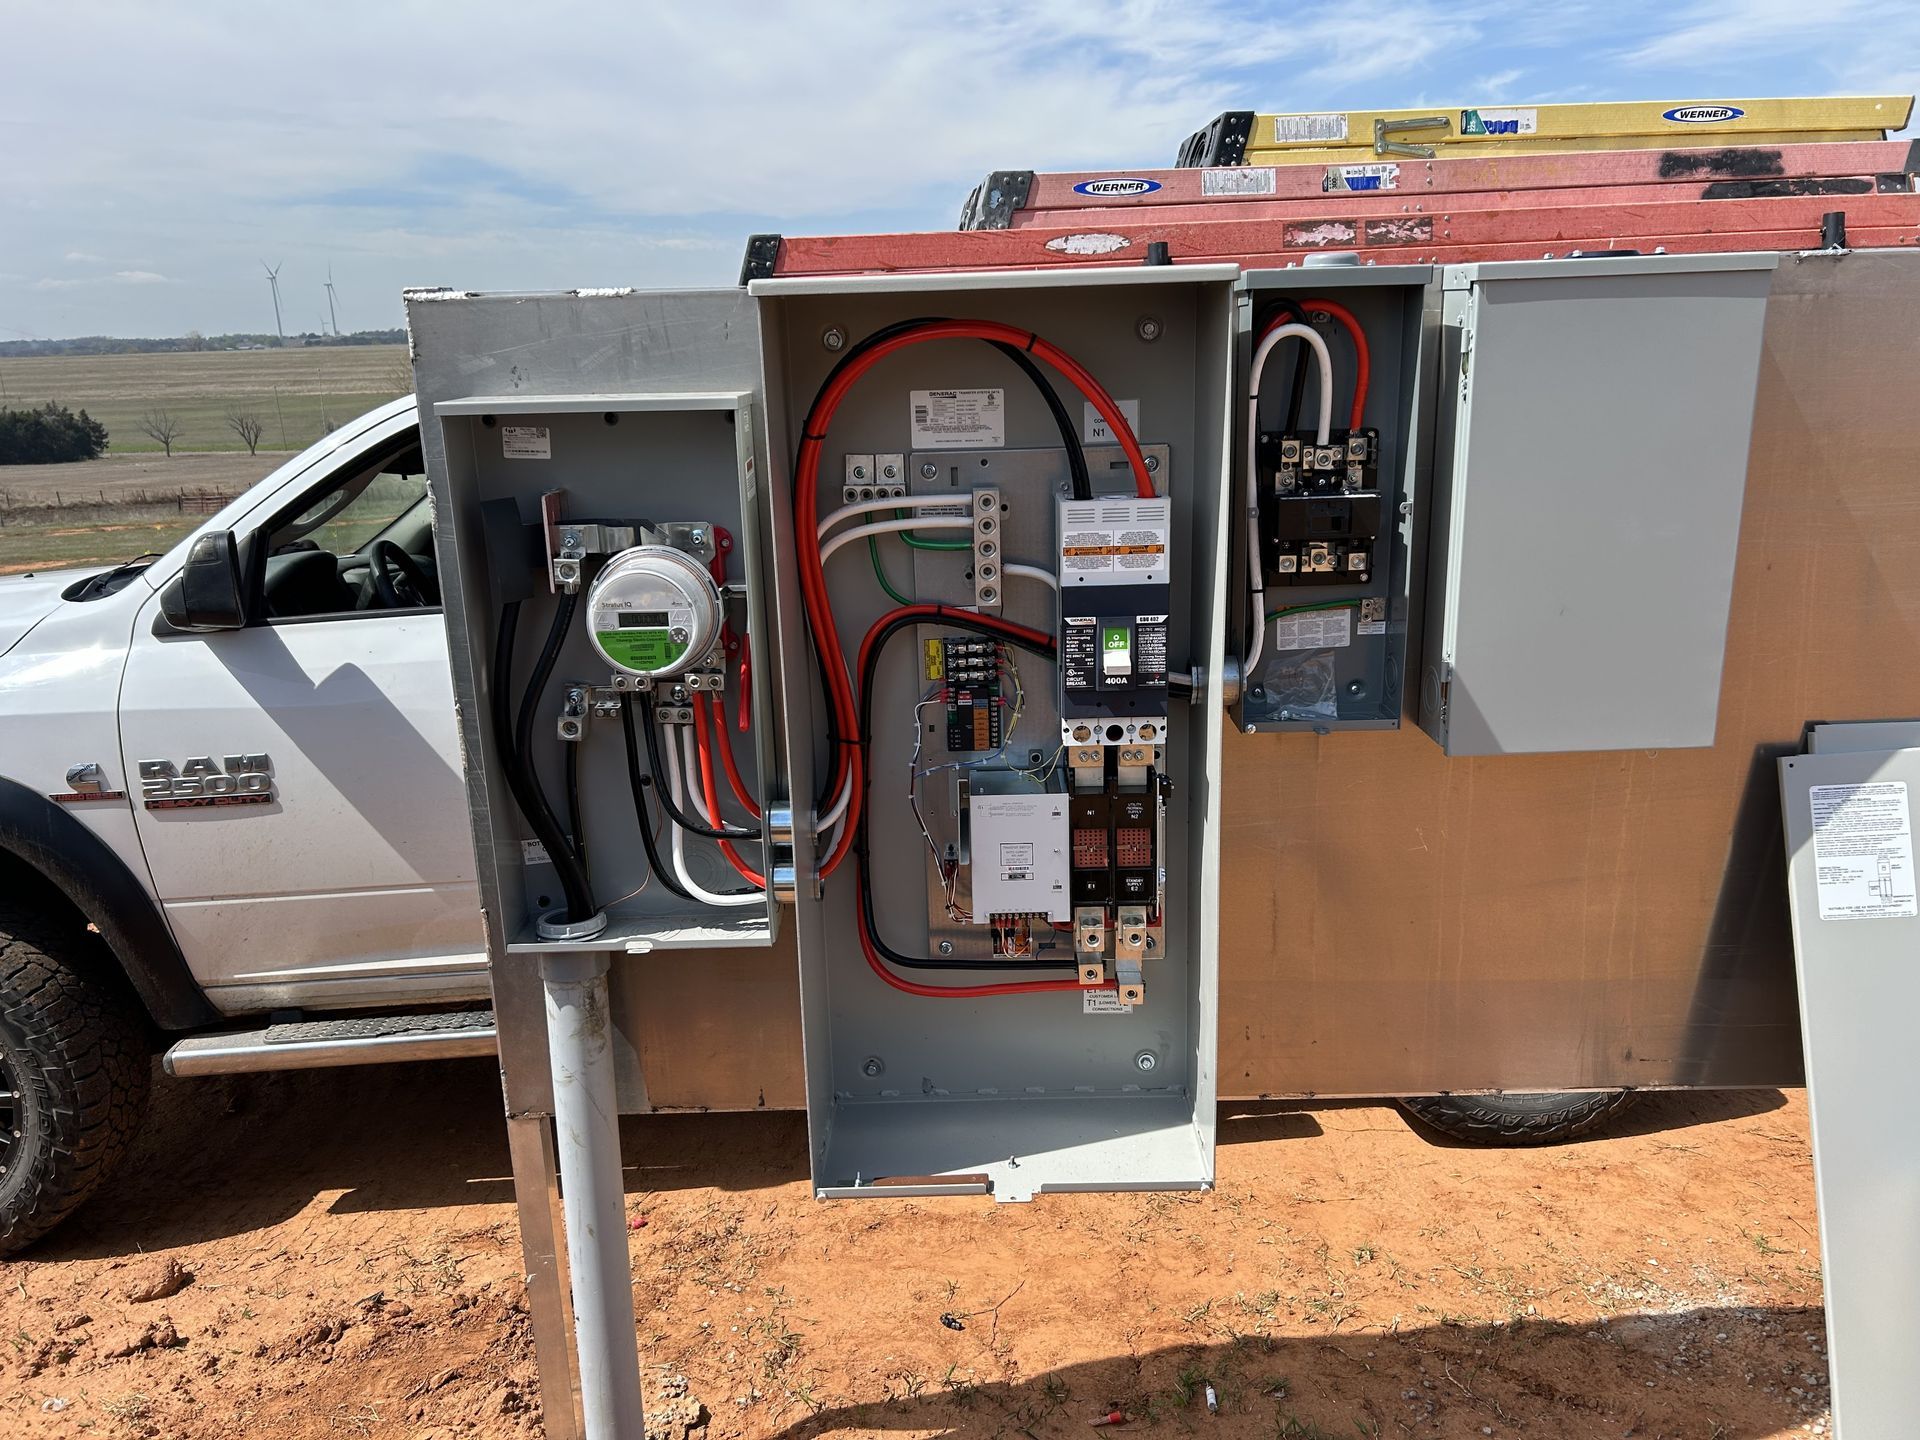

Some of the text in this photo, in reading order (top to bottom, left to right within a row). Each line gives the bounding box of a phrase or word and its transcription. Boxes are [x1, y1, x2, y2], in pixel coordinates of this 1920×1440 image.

[1680, 110, 1728, 119] WERNER
[1092, 183, 1145, 192] WERNER
[1093, 428, 1105, 437] N1
[1105, 677, 1128, 685] 400A
[138, 752, 270, 779] RAM
[141, 772, 272, 800] 2500
[148, 795, 267, 809] HEAVY DUTY
